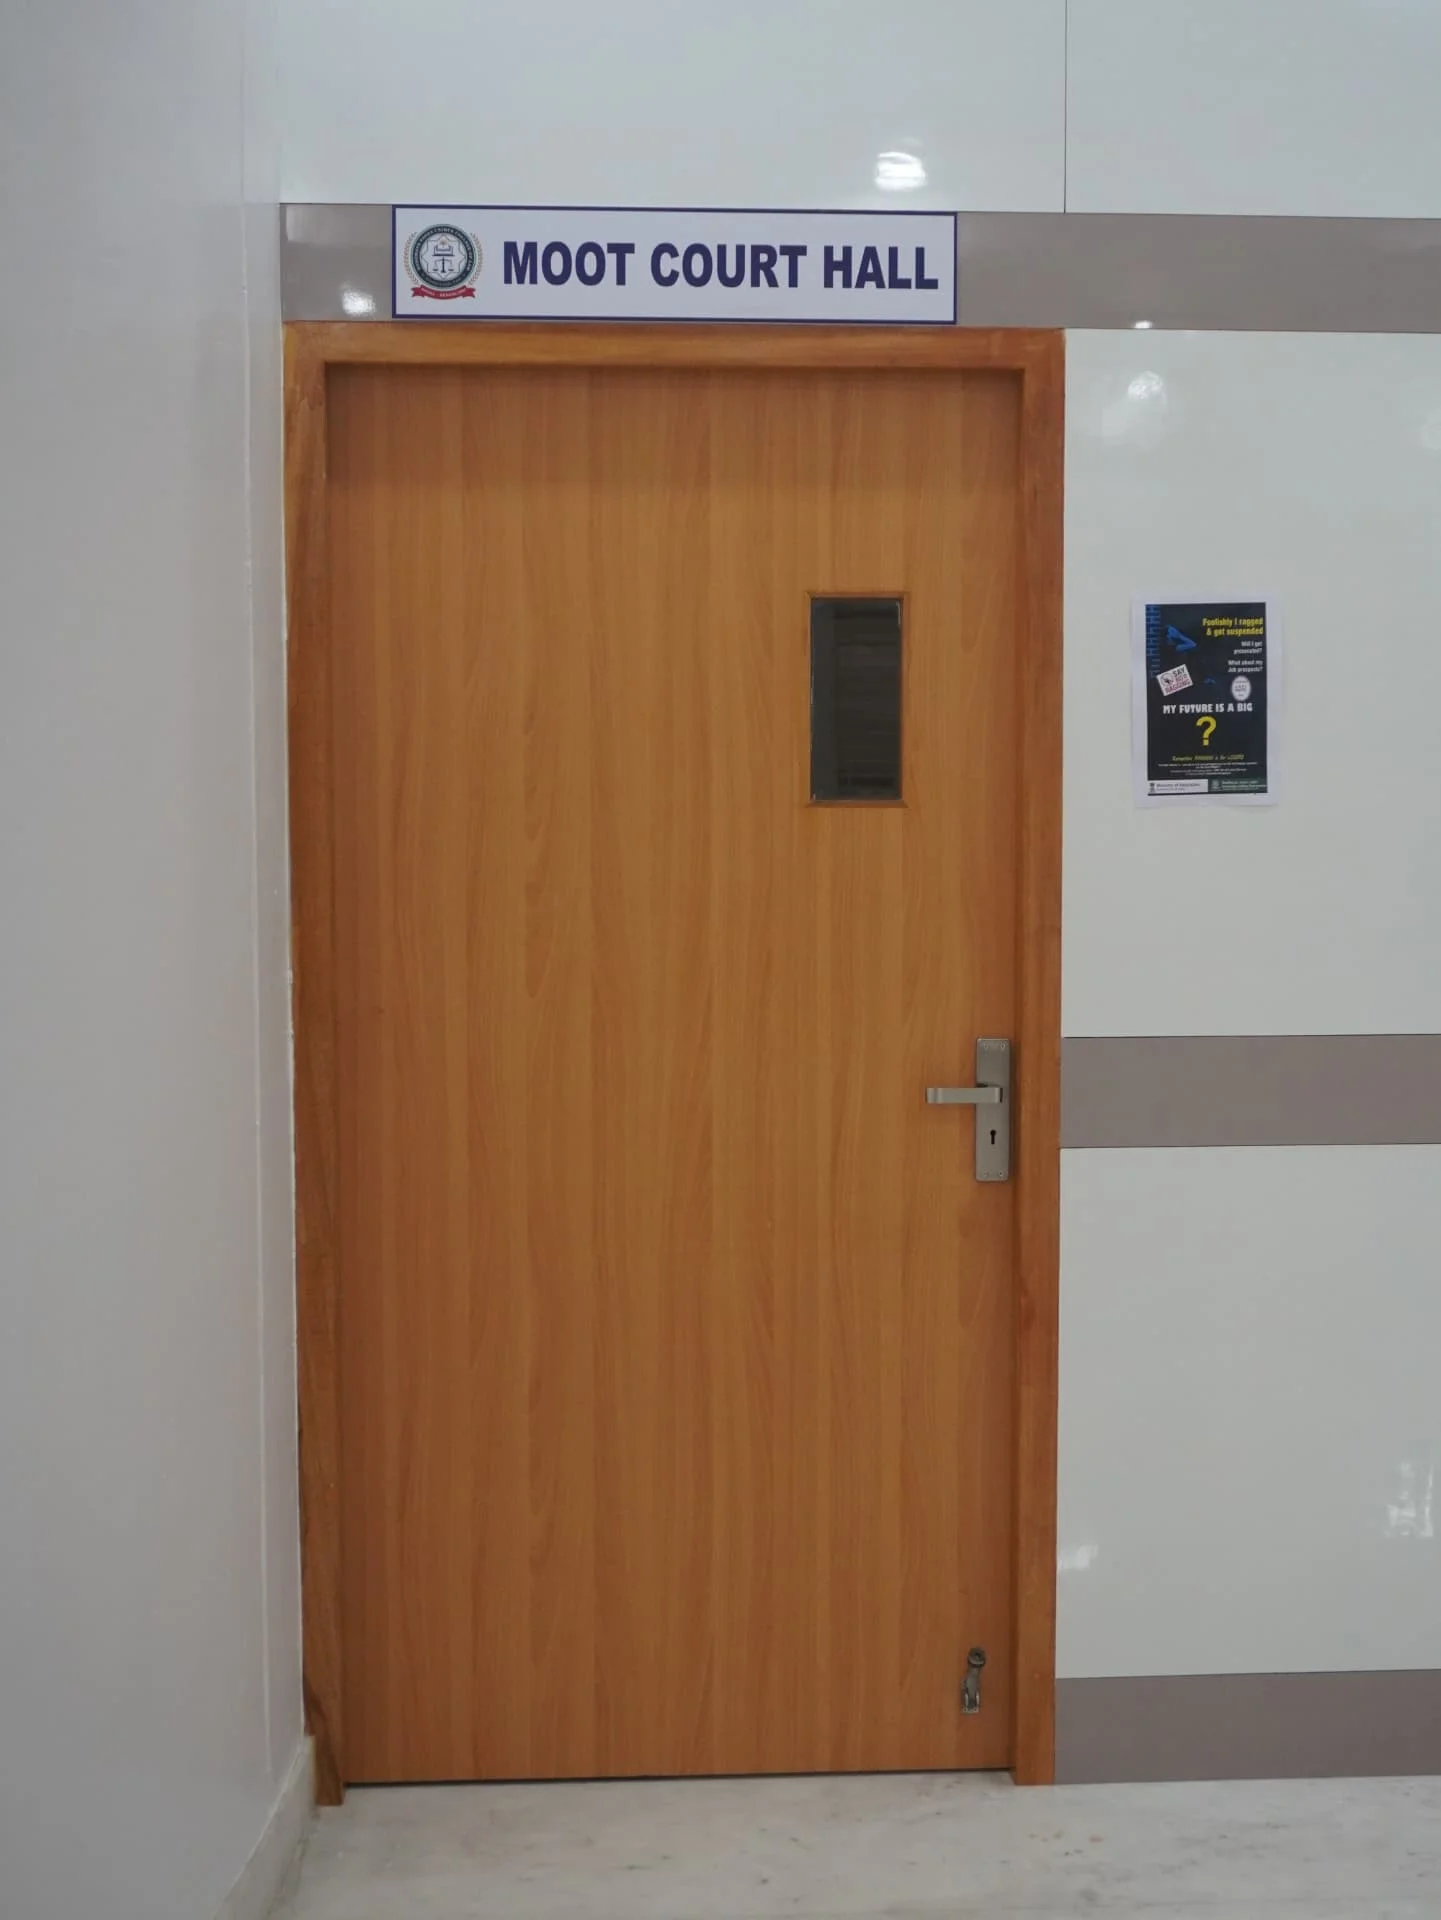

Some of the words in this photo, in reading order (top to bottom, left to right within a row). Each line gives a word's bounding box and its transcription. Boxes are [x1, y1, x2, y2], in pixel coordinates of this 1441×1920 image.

[503, 241, 636, 286] MOOT
[650, 243, 808, 288] COURT
[823, 245, 939, 290] HALL
[1239, 617, 1263, 627] ragged
[1206, 628, 1212, 636] &
[1227, 628, 1264, 636] suspended
[1163, 704, 1177, 714] MY
[1179, 703, 1213, 714] FUTURE
[1215, 703, 1225, 713] IS
[1227, 703, 1234, 712] A
[1237, 702, 1253, 712] BIG
[1196, 715, 1217, 746] ?
